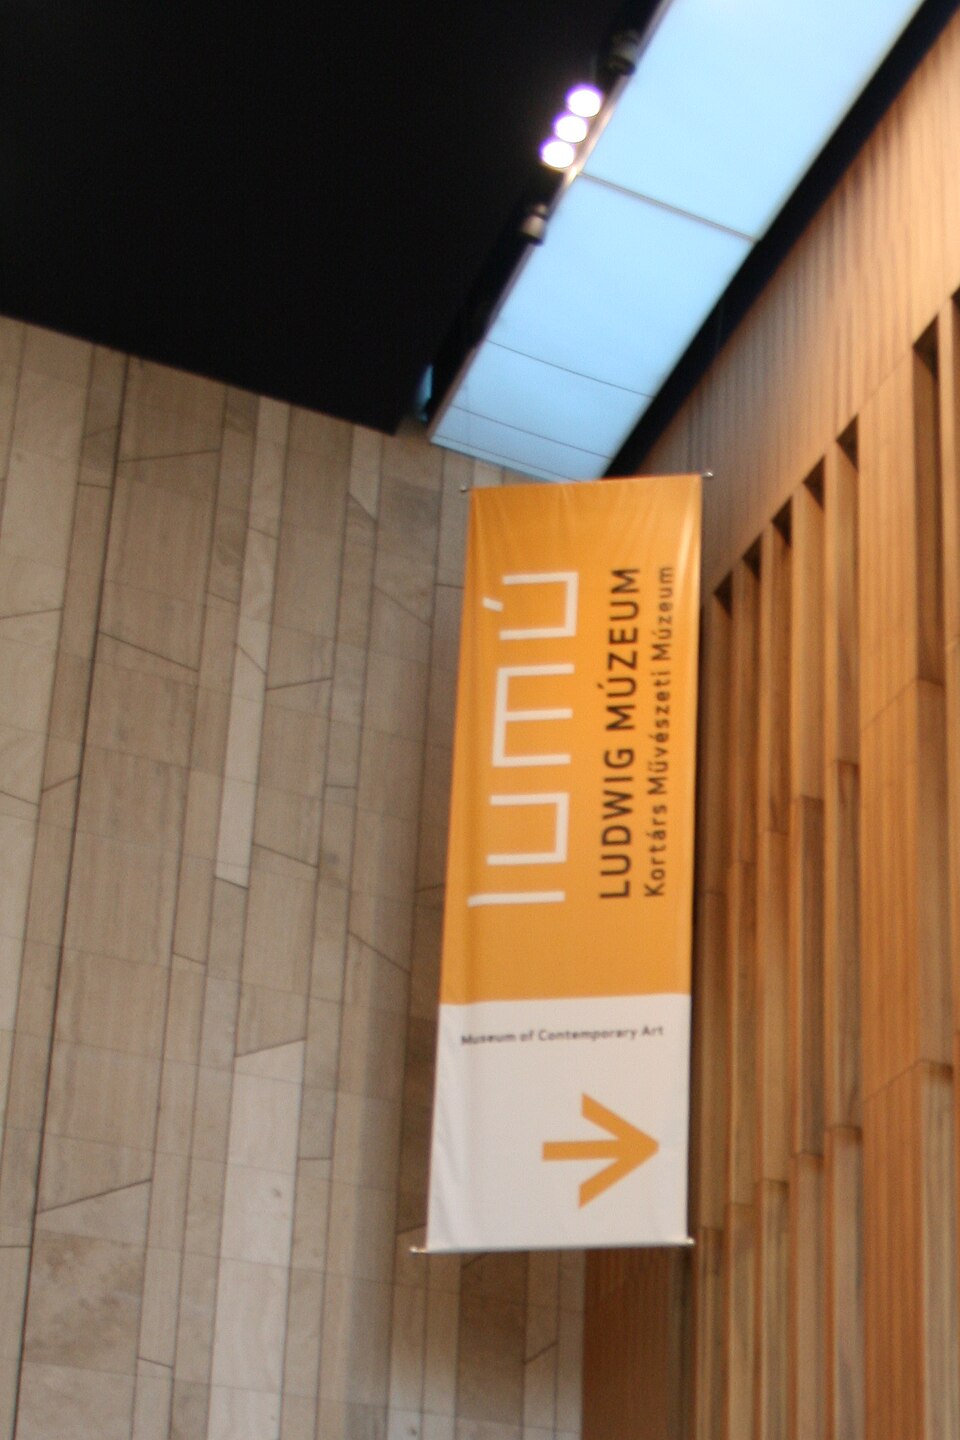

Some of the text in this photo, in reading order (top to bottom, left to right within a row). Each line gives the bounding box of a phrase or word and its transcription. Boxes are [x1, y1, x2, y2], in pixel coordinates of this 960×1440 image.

[596, 567, 640, 900] LUDWIG MÚZEUM
[644, 566, 674, 899] Kortárs Művészeti Múzeum
[461, 1025, 665, 1046] Museum of Contemporary Art
